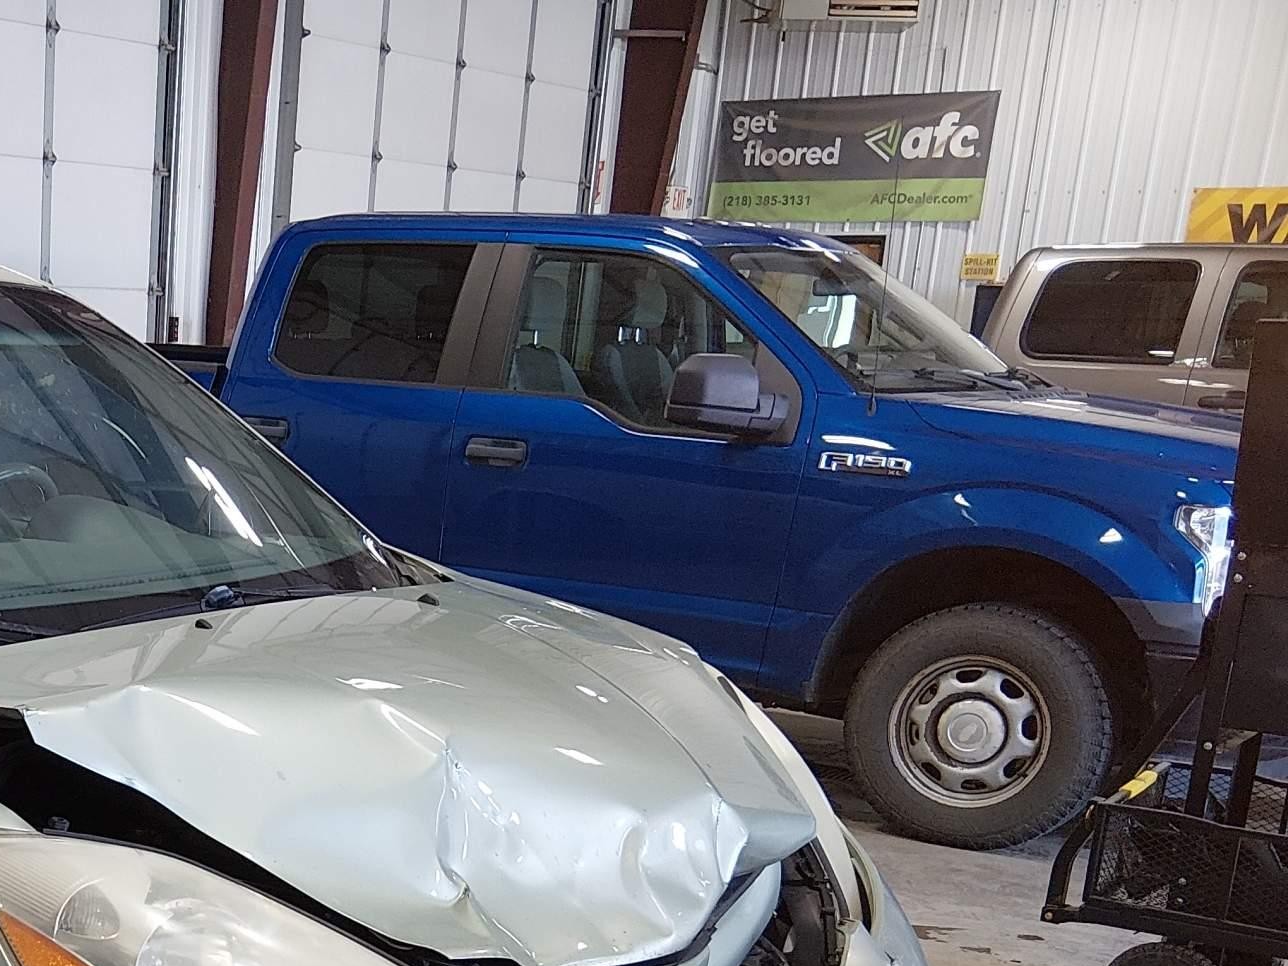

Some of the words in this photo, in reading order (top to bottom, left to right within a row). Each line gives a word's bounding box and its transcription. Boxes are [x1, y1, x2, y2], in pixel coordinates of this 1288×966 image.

[732, 110, 778, 141] get
[900, 111, 980, 160] afc
[743, 137, 841, 167] floored
[723, 196, 752, 209] (218)
[755, 195, 811, 207] 385-3131
[870, 192, 969, 206] AFCDealer.com
[1227, 203, 1288, 244] W
[964, 267, 994, 276] STATION
